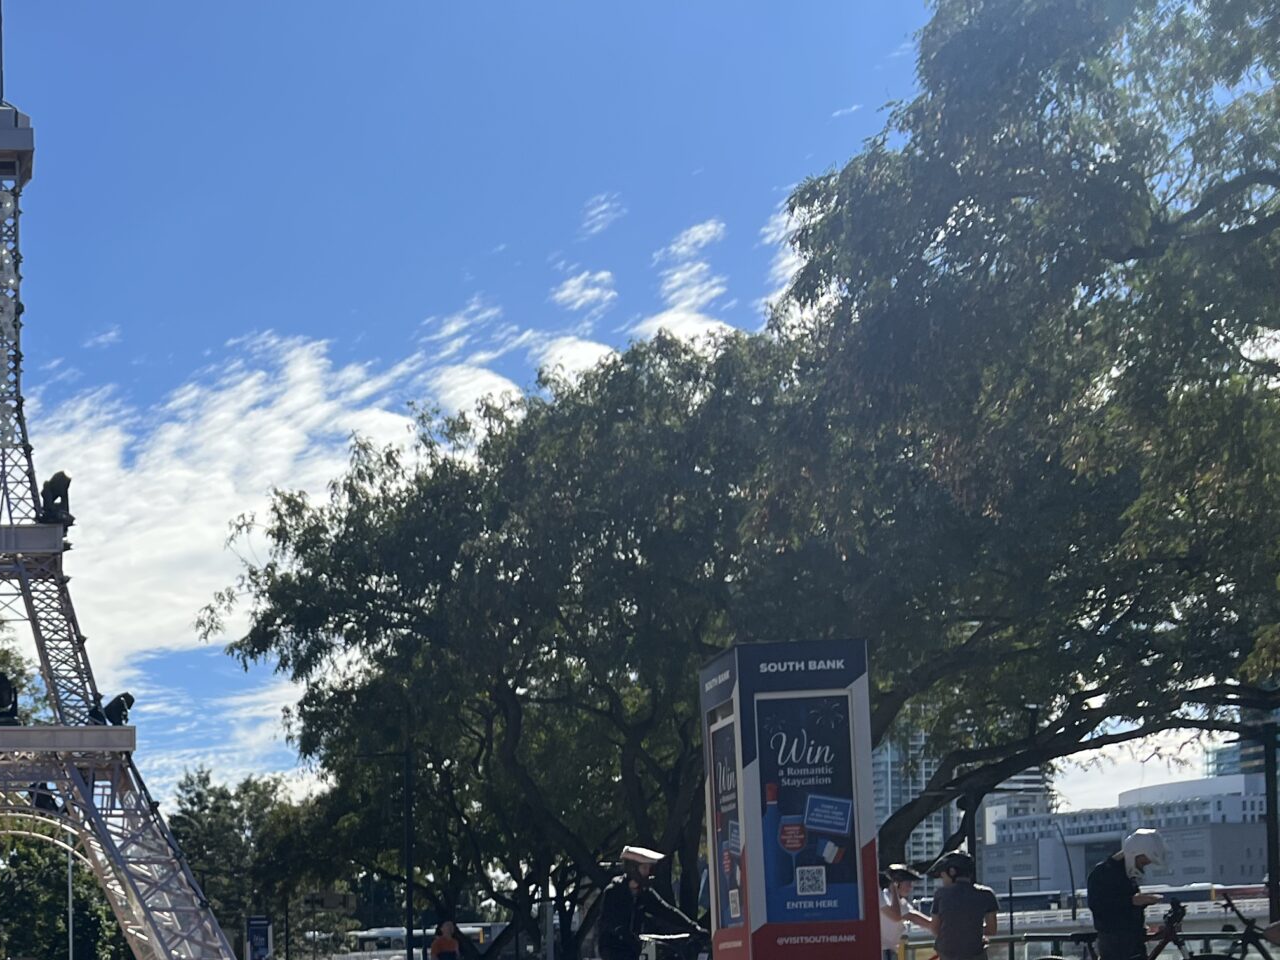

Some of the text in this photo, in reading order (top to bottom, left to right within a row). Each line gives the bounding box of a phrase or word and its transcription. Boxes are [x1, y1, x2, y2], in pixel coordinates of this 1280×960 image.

[759, 659, 845, 673] SOUTH BANK
[770, 728, 835, 766] Win
[787, 766, 833, 776] Romantic
[781, 775, 832, 787] Staycation
[786, 899, 839, 909] ENTER HERE
[776, 934, 857, 946] @VISITSOUTHBANK
